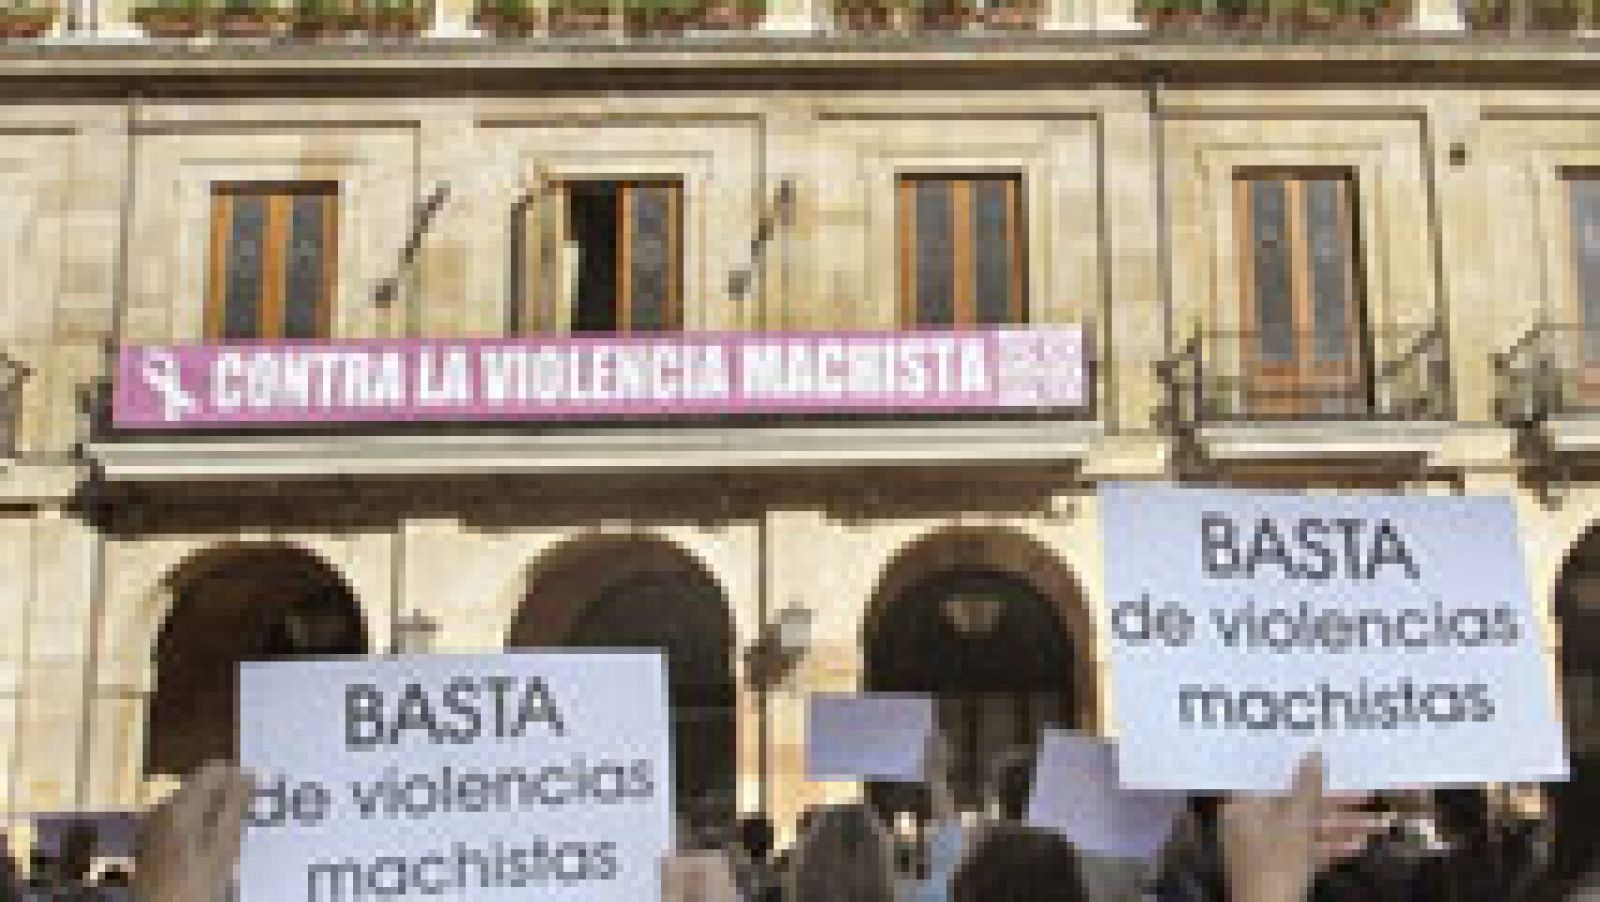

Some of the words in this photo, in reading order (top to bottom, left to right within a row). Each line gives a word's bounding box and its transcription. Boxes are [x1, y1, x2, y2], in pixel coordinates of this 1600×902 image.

[210, 344, 401, 408] CONTRA
[419, 343, 468, 404] LA
[481, 340, 722, 402] VIOLENCIA
[743, 337, 990, 400] MACHISTA
[1202, 512, 1420, 579] BASTA
[1111, 594, 1195, 647] de
[1209, 601, 1523, 650] violencias
[345, 676, 564, 751] BASTA
[1178, 677, 1495, 730] machistas
[248, 772, 331, 827] de
[352, 759, 654, 819] violencias
[307, 835, 617, 901] machistas
